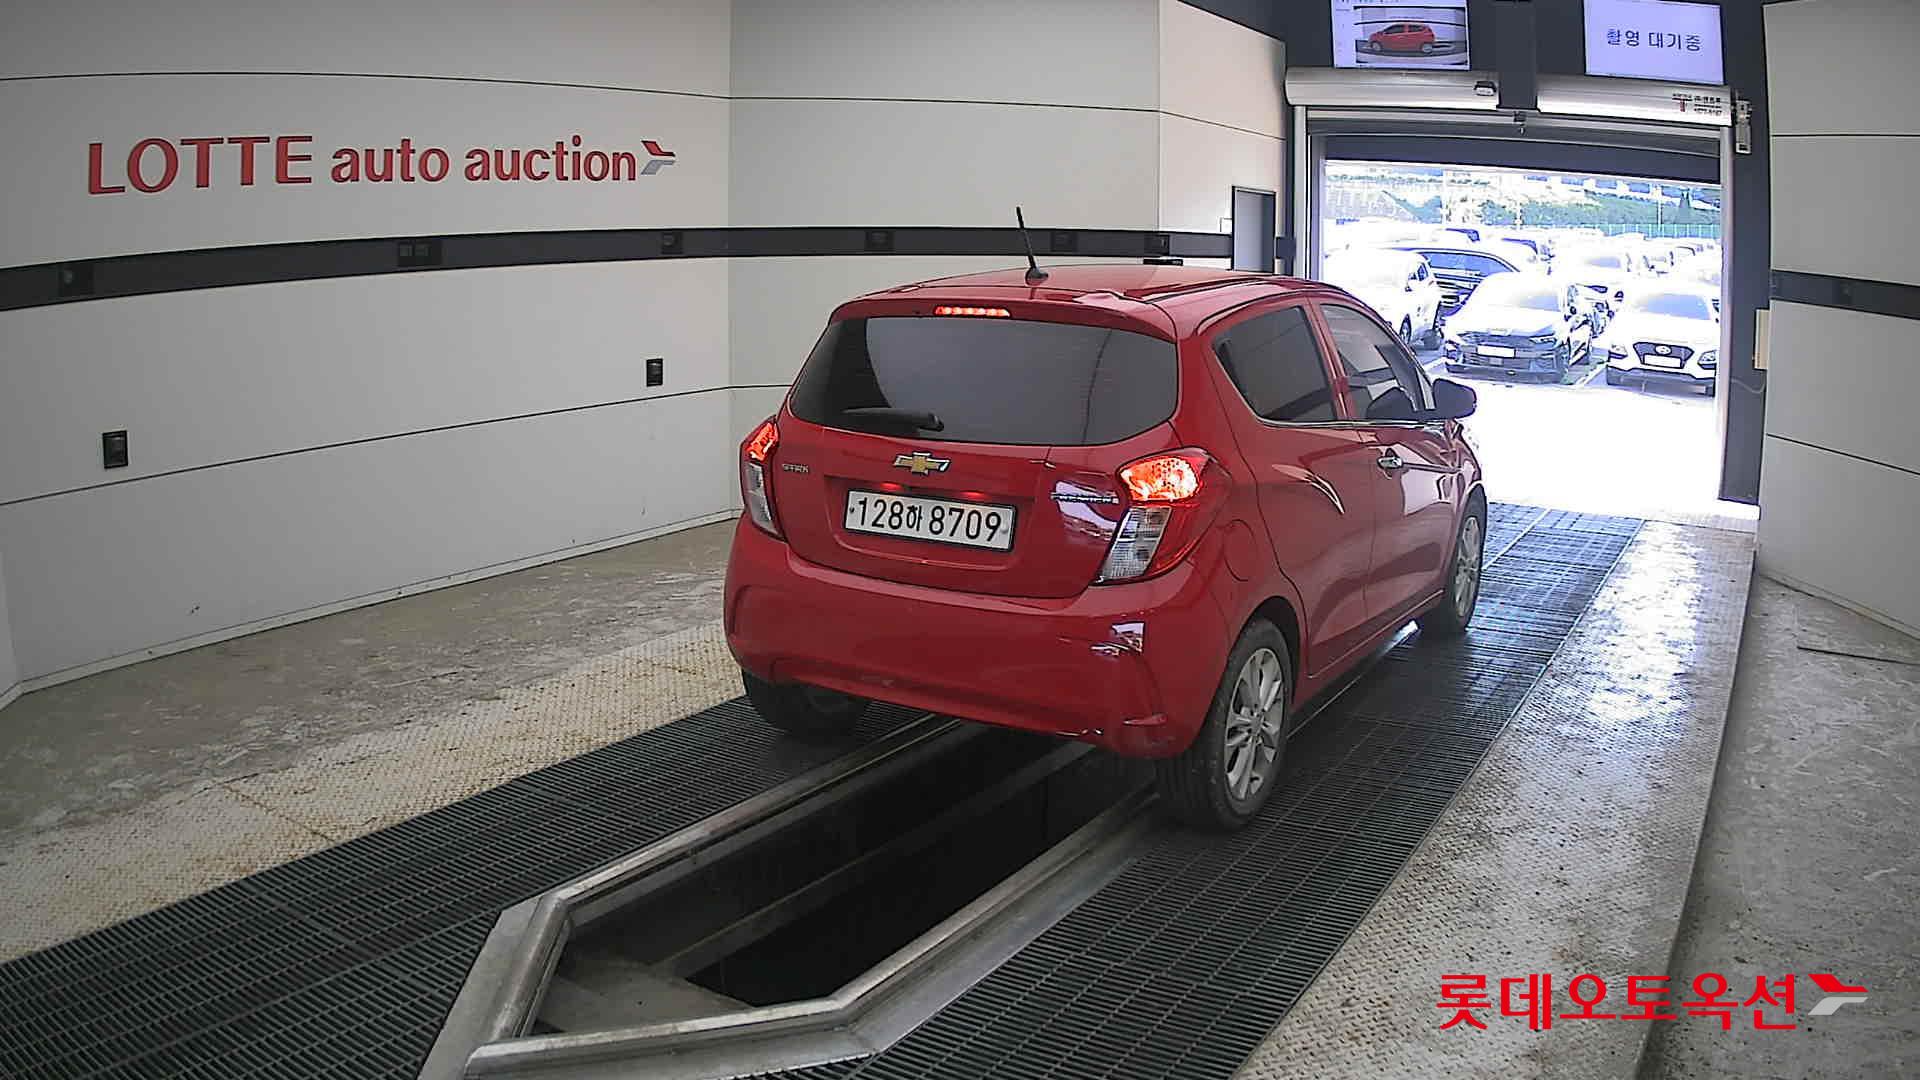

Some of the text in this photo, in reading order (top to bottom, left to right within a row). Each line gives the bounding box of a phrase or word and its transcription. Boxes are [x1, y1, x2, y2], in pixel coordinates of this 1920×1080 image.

[1648, 32, 1701, 51] 대기중
[88, 135, 637, 195] LOTTE auto auction
[858, 496, 1002, 542] 128하 8709
